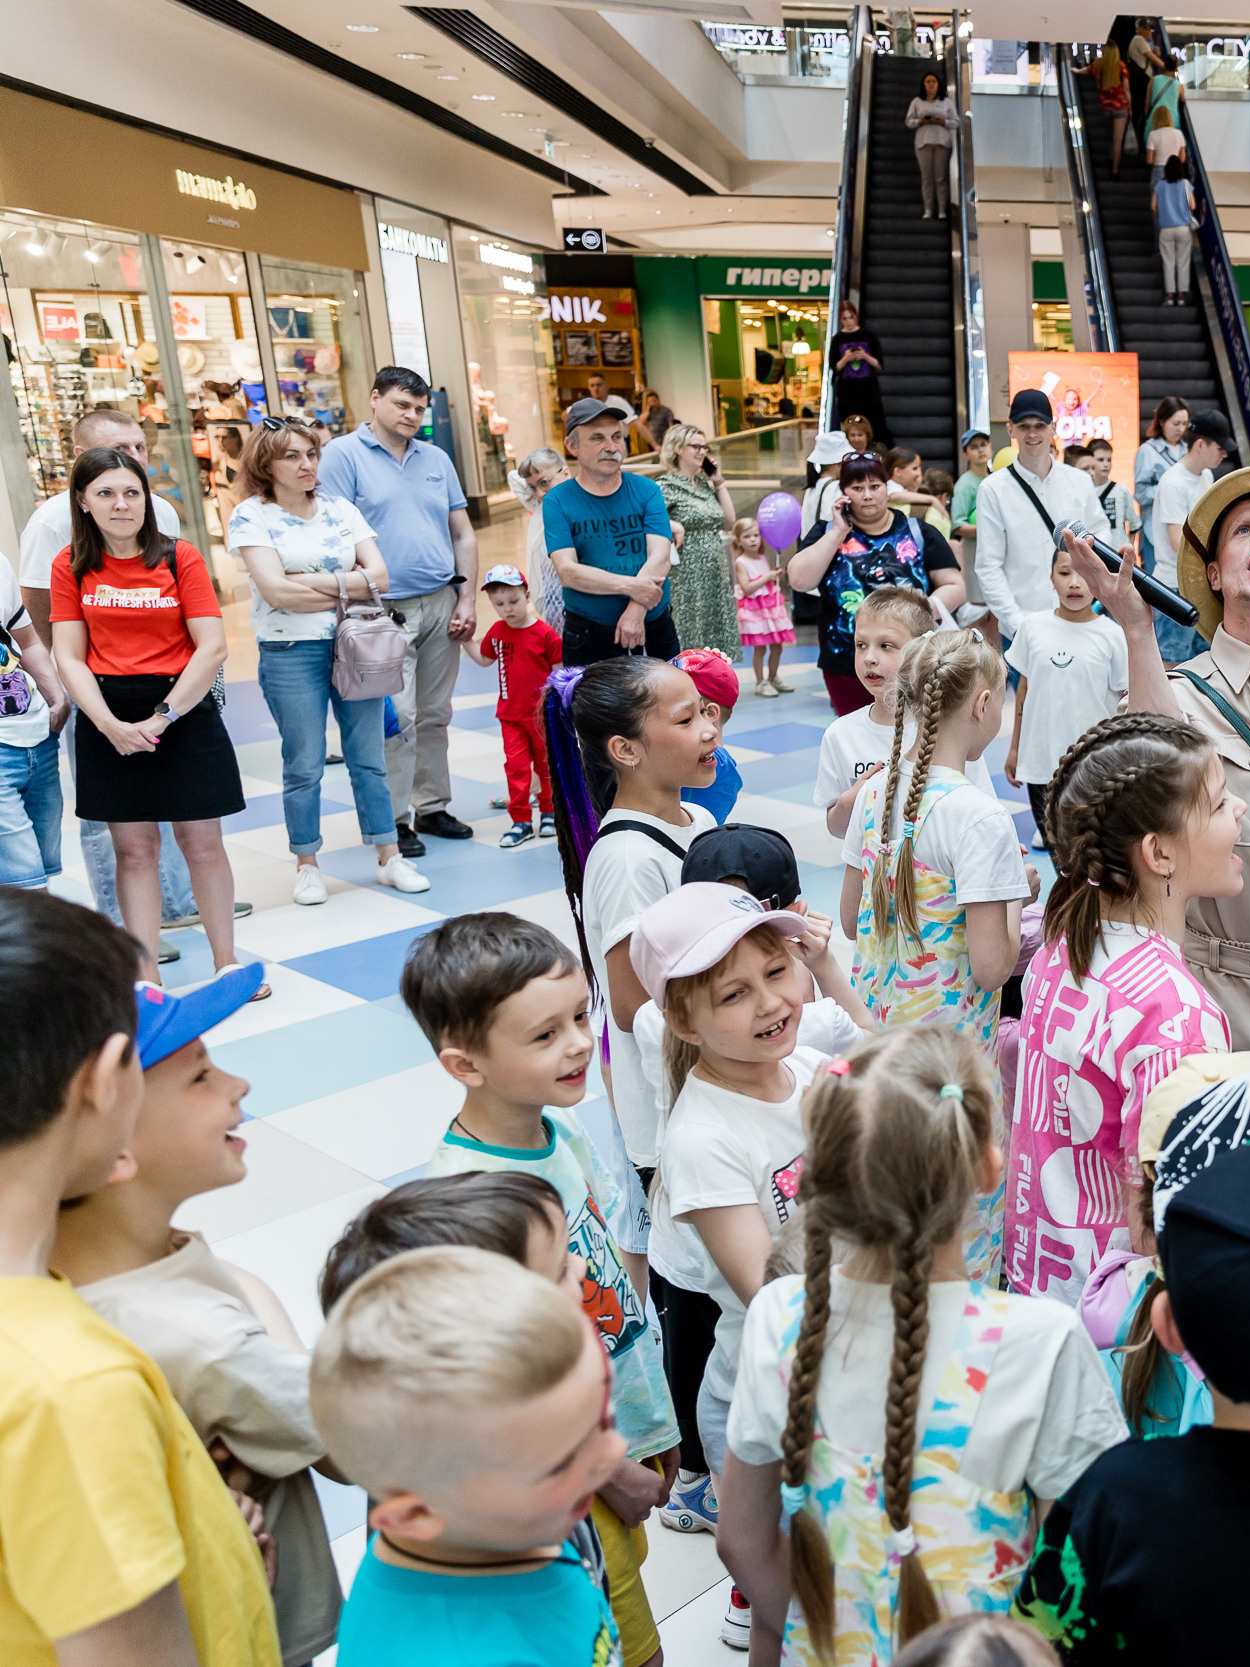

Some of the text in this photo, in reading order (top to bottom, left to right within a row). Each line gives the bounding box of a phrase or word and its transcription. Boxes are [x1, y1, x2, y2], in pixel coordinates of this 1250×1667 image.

[378, 222, 449, 264] БАНКОМАТЫ
[1052, 415, 1113, 440] ОНЯ
[99, 588, 155, 598] MONDAYS
[112, 598, 144, 608] FRESH
[144, 597, 178, 608] STARTS
[1053, 1074, 1070, 1137] FILA
[1016, 1153, 1032, 1215] FILA
[1012, 1224, 1029, 1282] FILA
